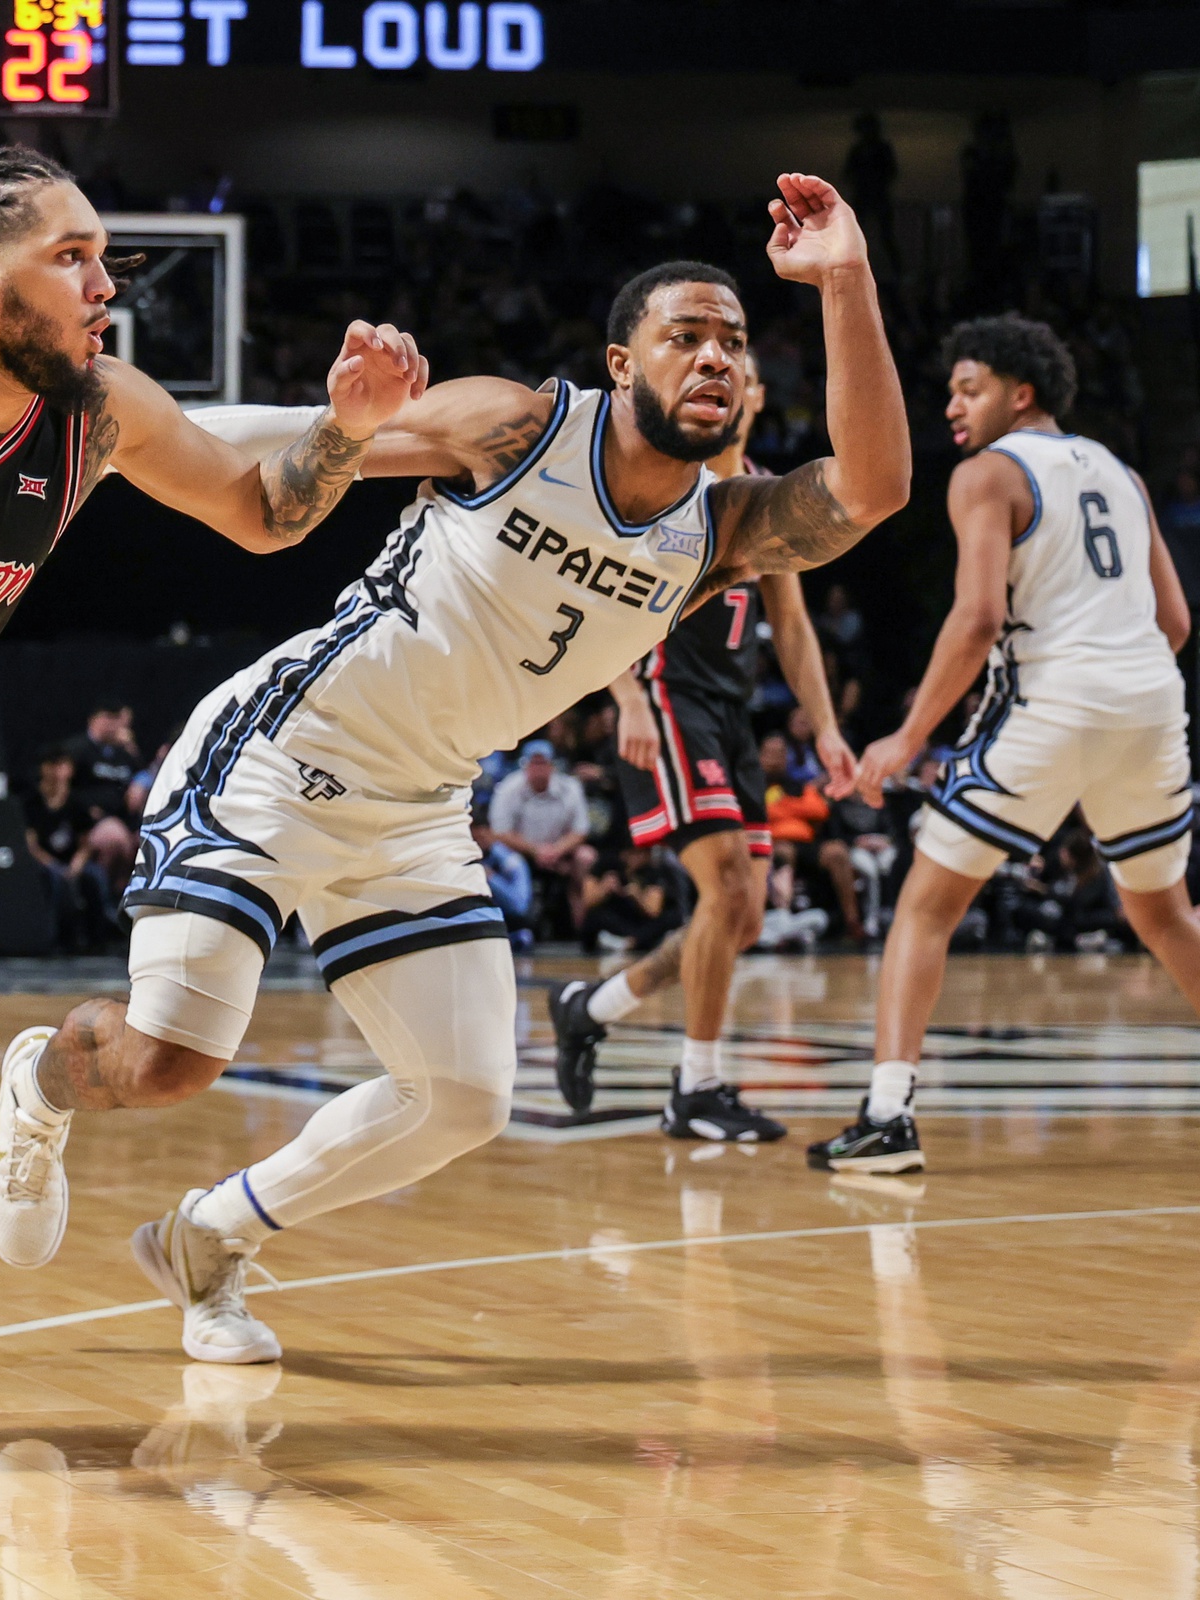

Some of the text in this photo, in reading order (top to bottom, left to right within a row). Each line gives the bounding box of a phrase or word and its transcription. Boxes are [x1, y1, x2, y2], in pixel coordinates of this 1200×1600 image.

[2, 29, 93, 102] 22
[300, 1, 544, 71] LOUD
[496, 507, 684, 613] SPACEU
[1080, 492, 1123, 578] 6
[519, 602, 585, 676] 3
[724, 588, 749, 650] 7
